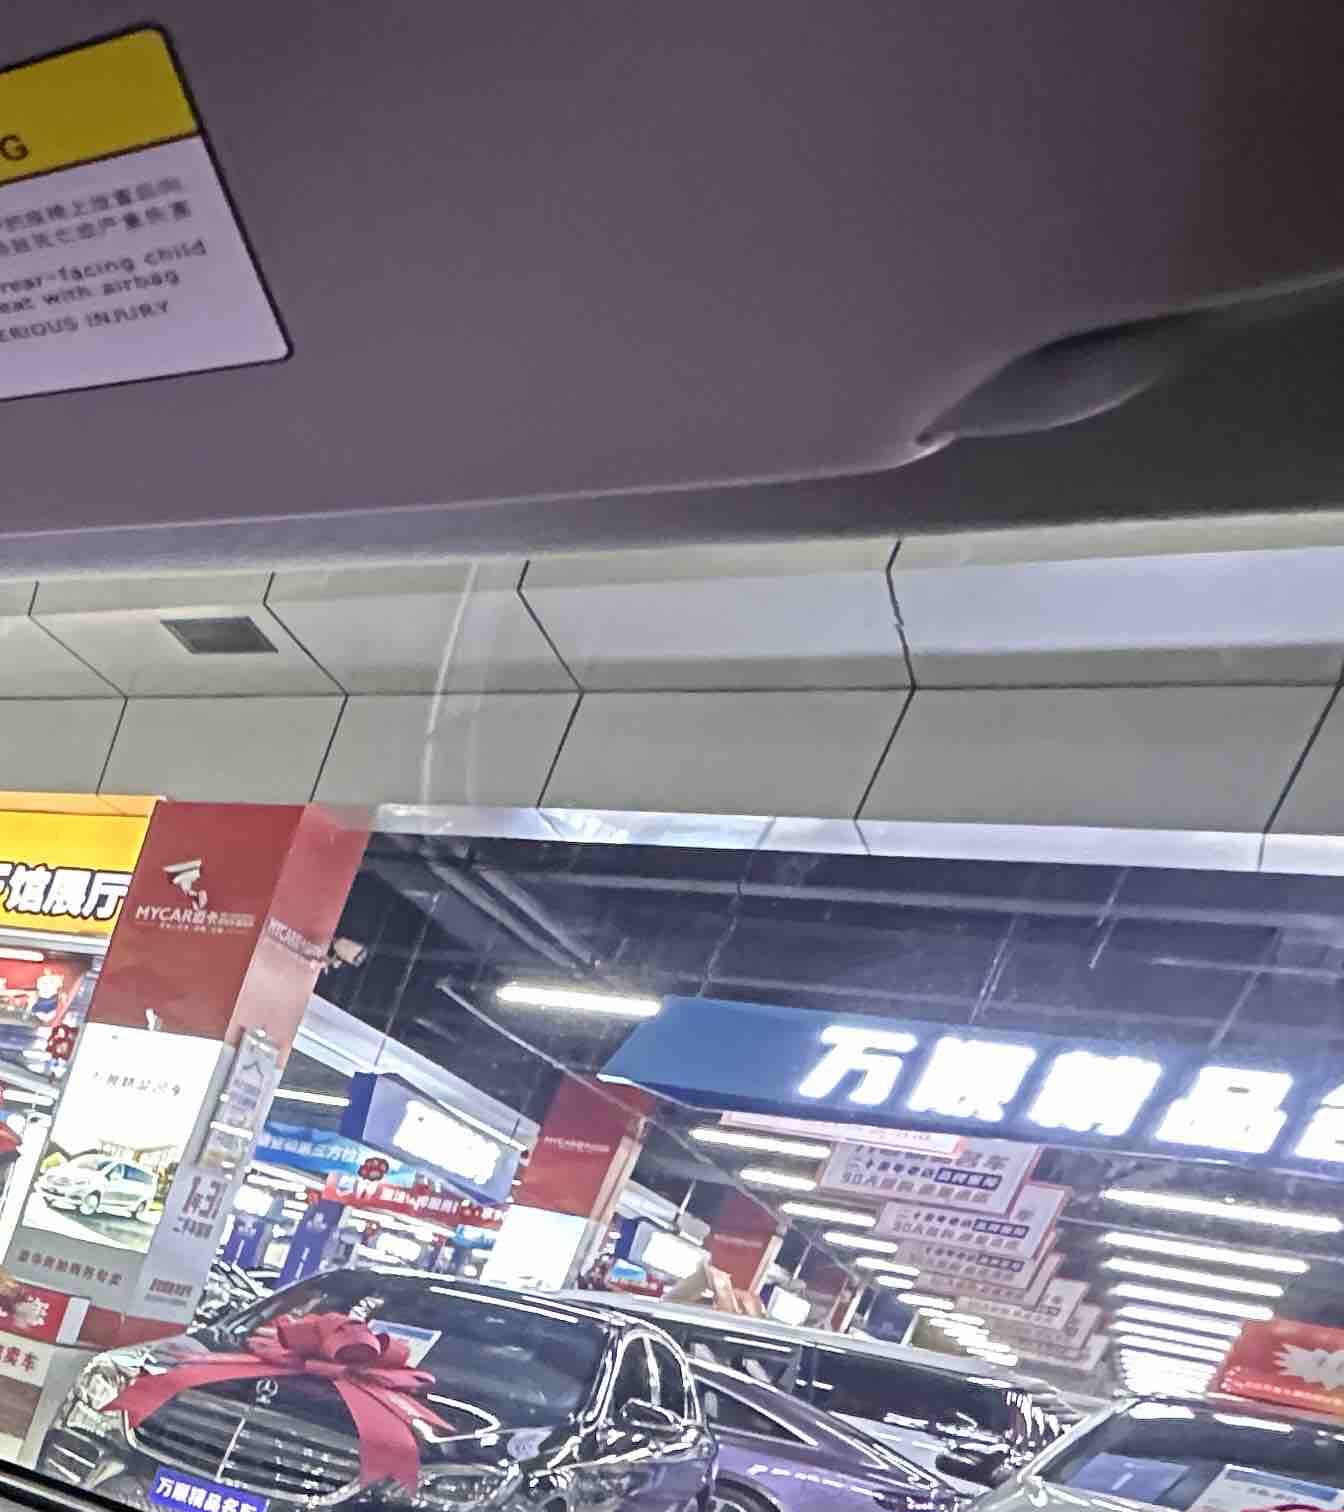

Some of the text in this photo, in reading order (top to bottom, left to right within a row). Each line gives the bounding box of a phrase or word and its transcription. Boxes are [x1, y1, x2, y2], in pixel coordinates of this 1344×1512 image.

[0, 255, 136, 295] rear-facing
[144, 238, 207, 265] child
[42, 283, 93, 306] with
[103, 267, 182, 295] airbag
[86, 299, 170, 329] INJURY
